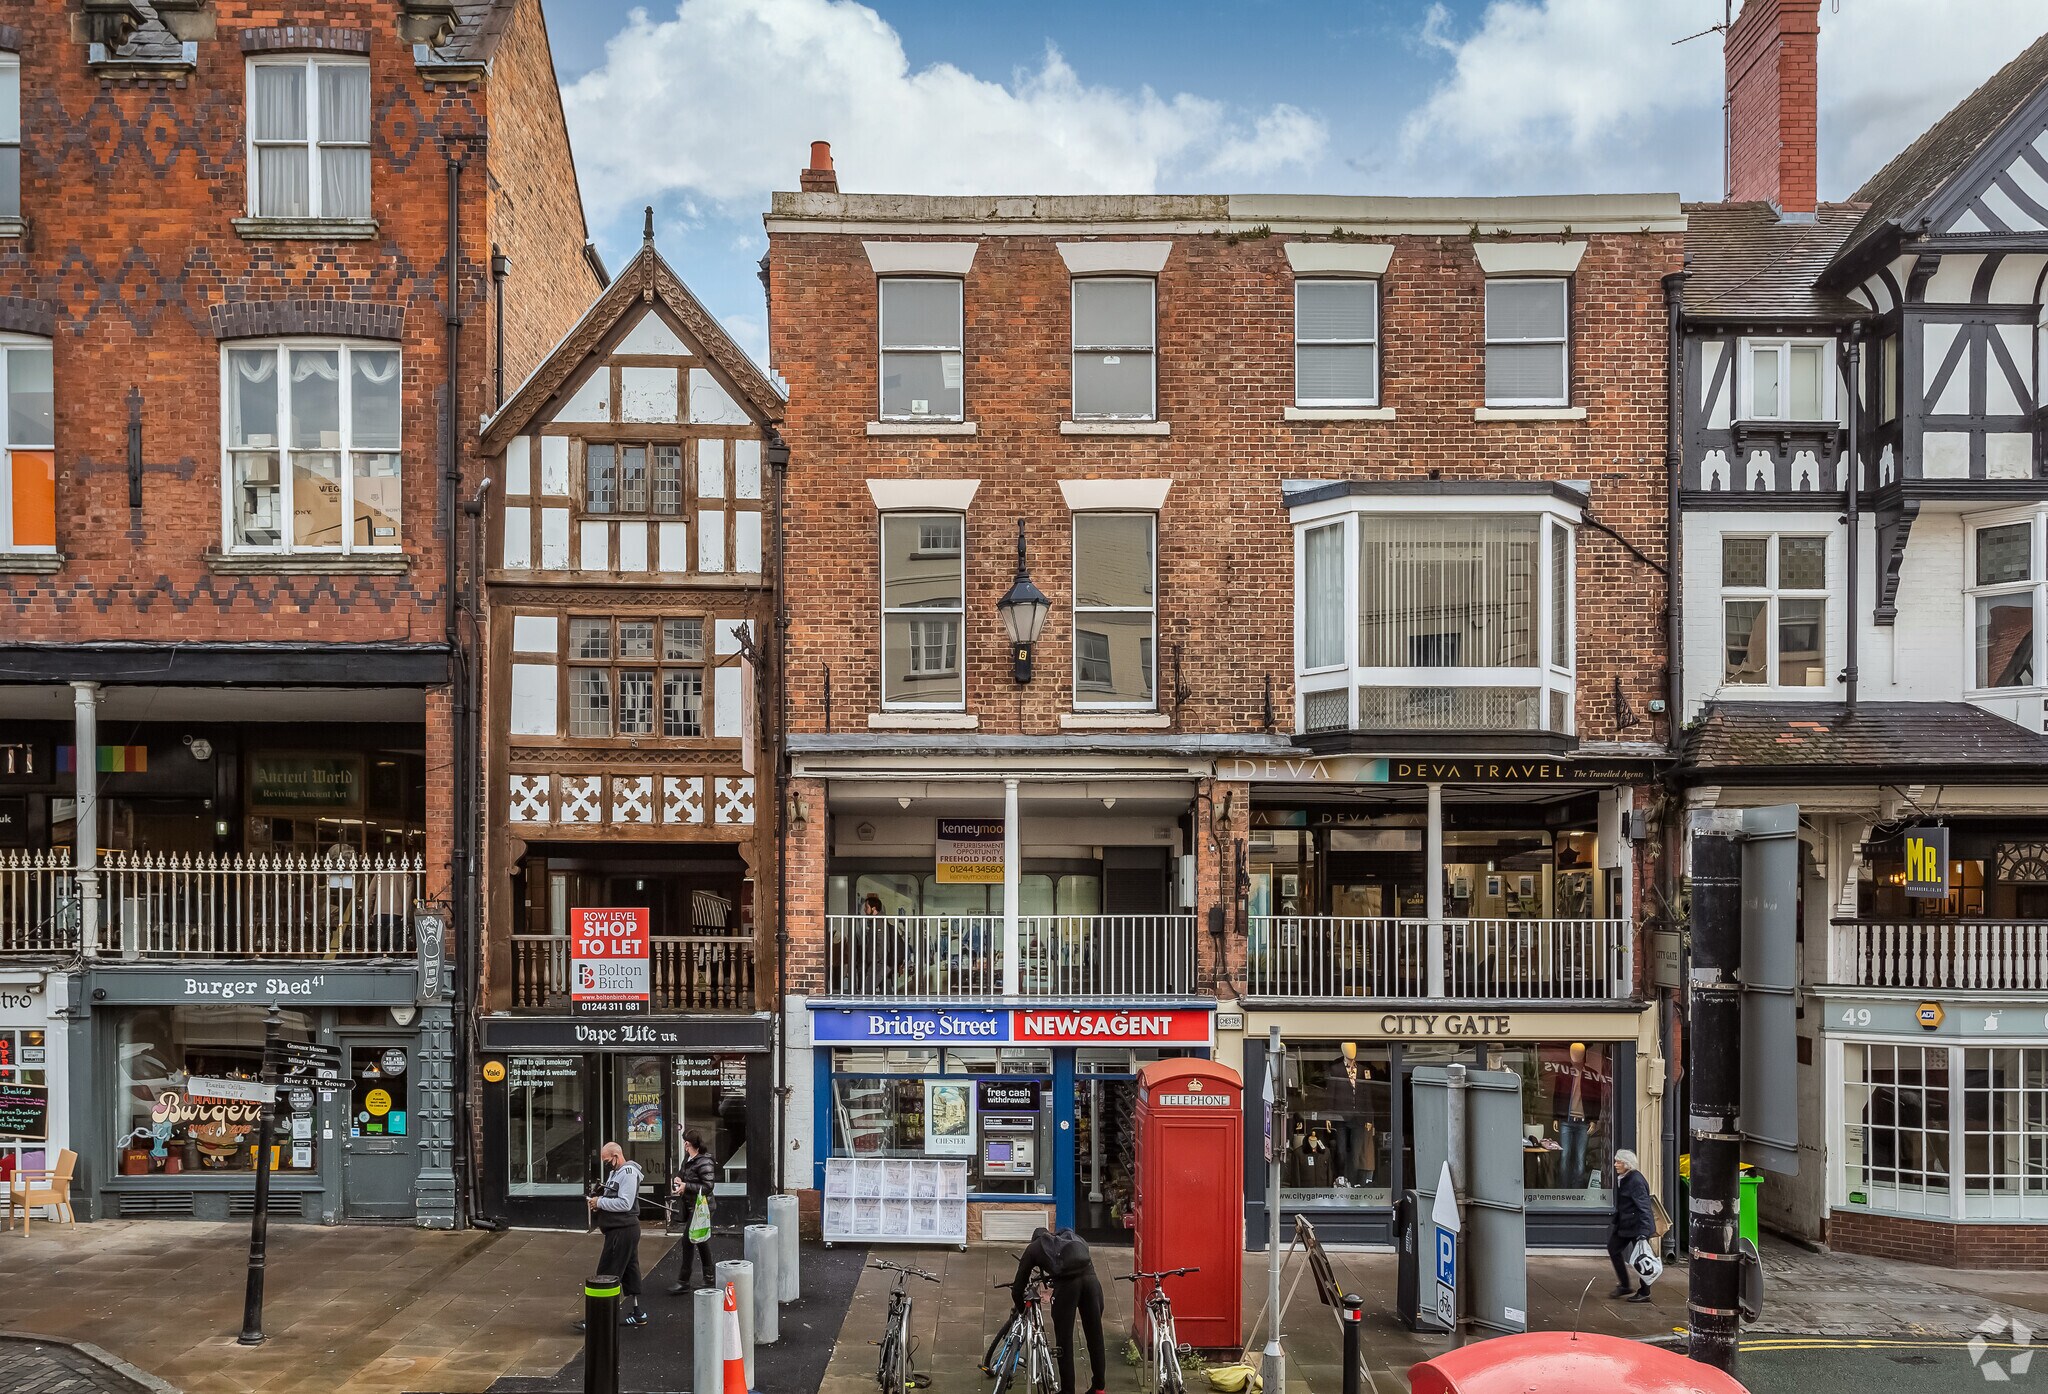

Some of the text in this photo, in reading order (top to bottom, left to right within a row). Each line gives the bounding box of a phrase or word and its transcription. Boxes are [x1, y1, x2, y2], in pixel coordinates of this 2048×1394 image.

[1232, 759, 1331, 779] DEVA
[1399, 764, 1644, 780] DEVA TRAVEL The Travelled Agents
[263, 790, 298, 799] Reviving
[300, 790, 330, 798] Ancient
[942, 821, 1004, 837] kenneymoo
[583, 912, 637, 921] ROW LEVEL
[583, 921, 637, 937] SHOP
[579, 939, 642, 955] TO LET
[599, 964, 642, 976] Bolton
[184, 978, 258, 998] Burger
[599, 976, 633, 989] Birch
[0, 992, 32, 1009] tro
[581, 1003, 640, 1011] 01244 311 681
[1841, 1008, 1872, 1027] 49
[1921, 1011, 1935, 1019] ADT
[867, 1014, 998, 1040] Bridge Street
[1024, 1014, 1173, 1036] NEWSAGENT
[1380, 1015, 1511, 1035] CITY GATE
[574, 1025, 617, 1044] Vape
[621, 1025, 657, 1042] Life
[535, 1059, 546, 1067] quit
[547, 1059, 573, 1067] smoking?
[695, 1058, 711, 1066] vape?
[486, 1069, 501, 1077] Yale
[676, 1069, 690, 1077] Enjoy
[310, 1078, 323, 1086] The
[324, 1080, 346, 1088] Groves
[531, 1080, 543, 1088] help
[987, 1087, 1031, 1097] free cash
[628, 1093, 660, 1105] GANDEYS
[987, 1096, 1031, 1104] withdrawals
[1162, 1095, 1227, 1105] TELEPHONE
[1440, 1233, 1453, 1278] P
